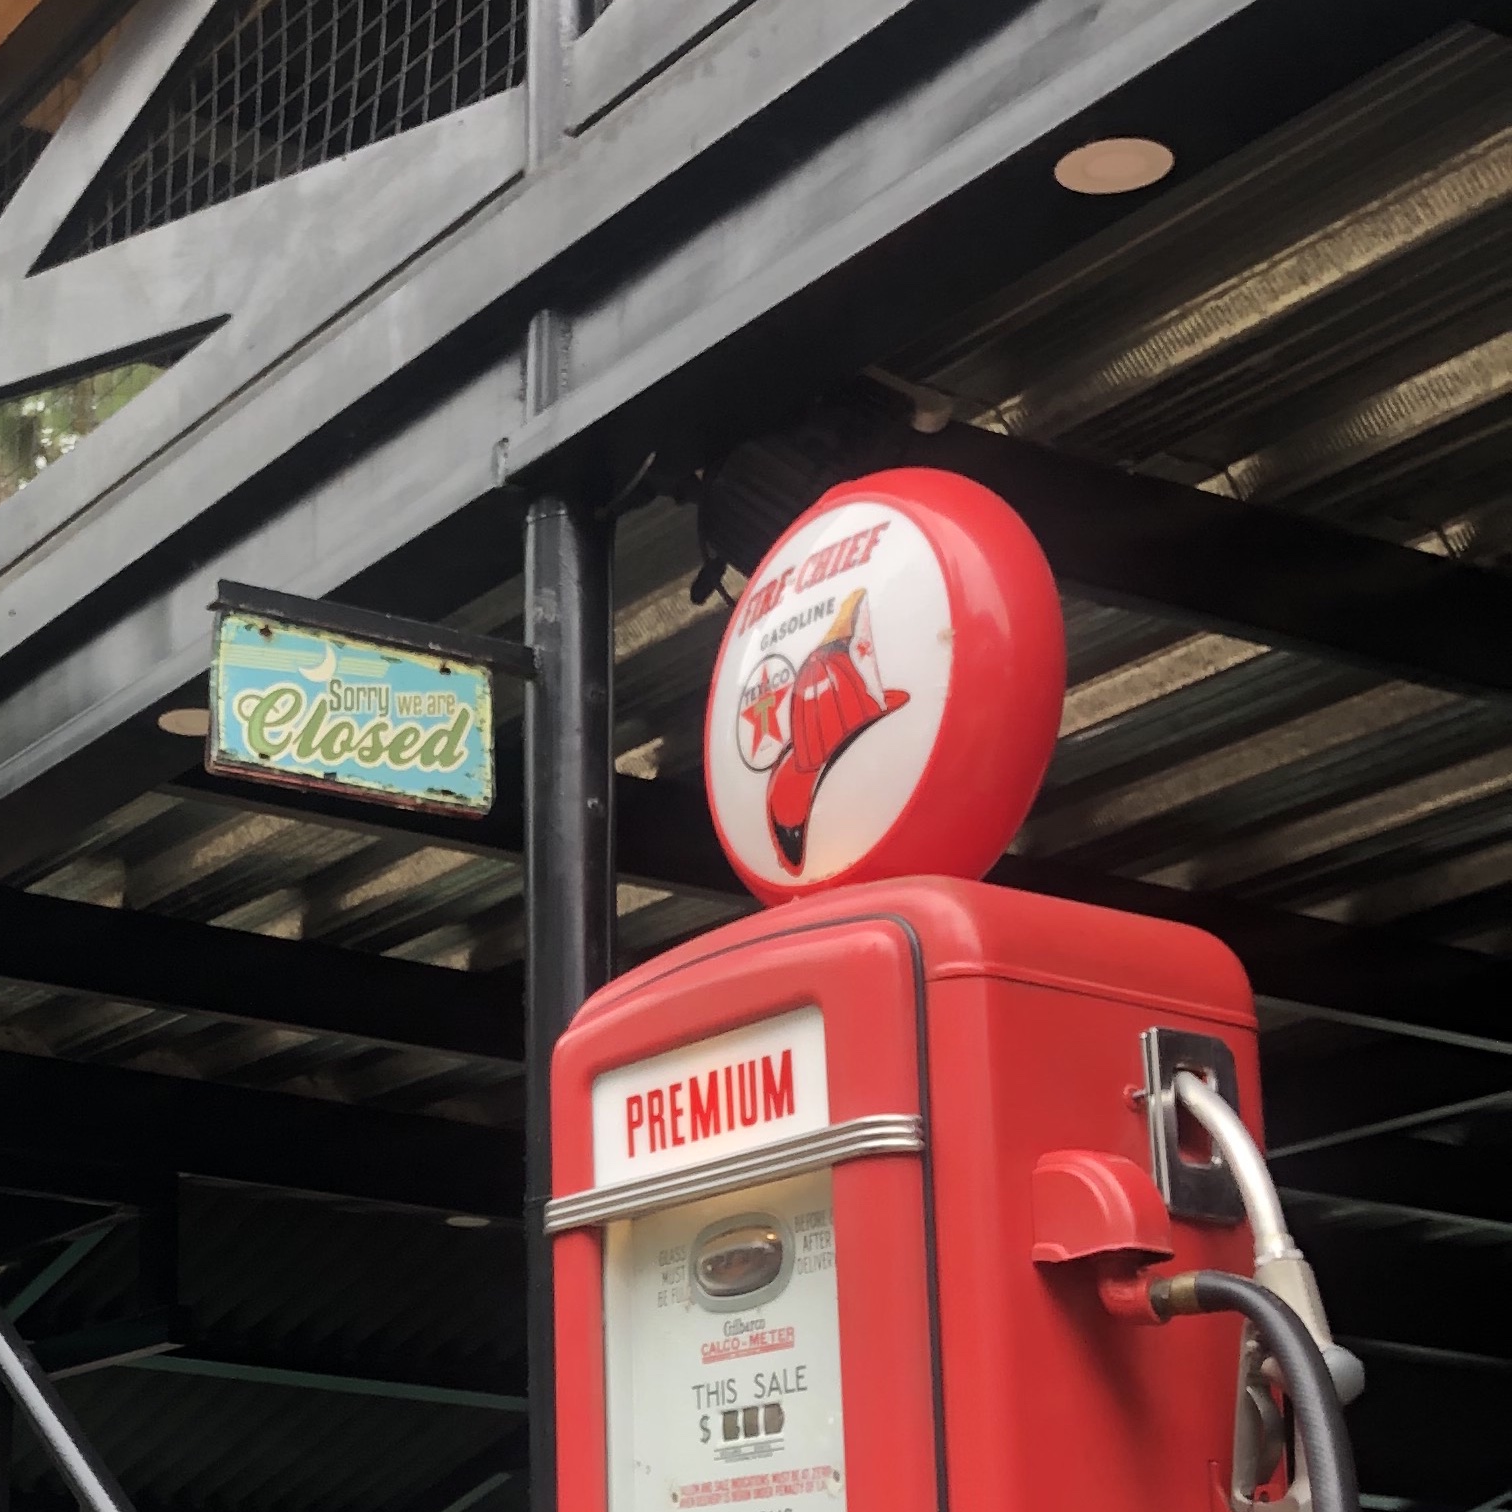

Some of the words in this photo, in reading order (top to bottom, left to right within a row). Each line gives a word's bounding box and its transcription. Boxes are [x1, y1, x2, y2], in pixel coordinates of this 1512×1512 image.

[760, 597, 836, 651] GASOLINE
[329, 679, 389, 717] Sorry
[396, 694, 423, 716] we
[427, 693, 456, 716] are
[236, 687, 471, 768] Closed
[626, 1049, 795, 1158] PREMIUM
[691, 1377, 738, 1411] THIS
[753, 1364, 808, 1399] SALE
